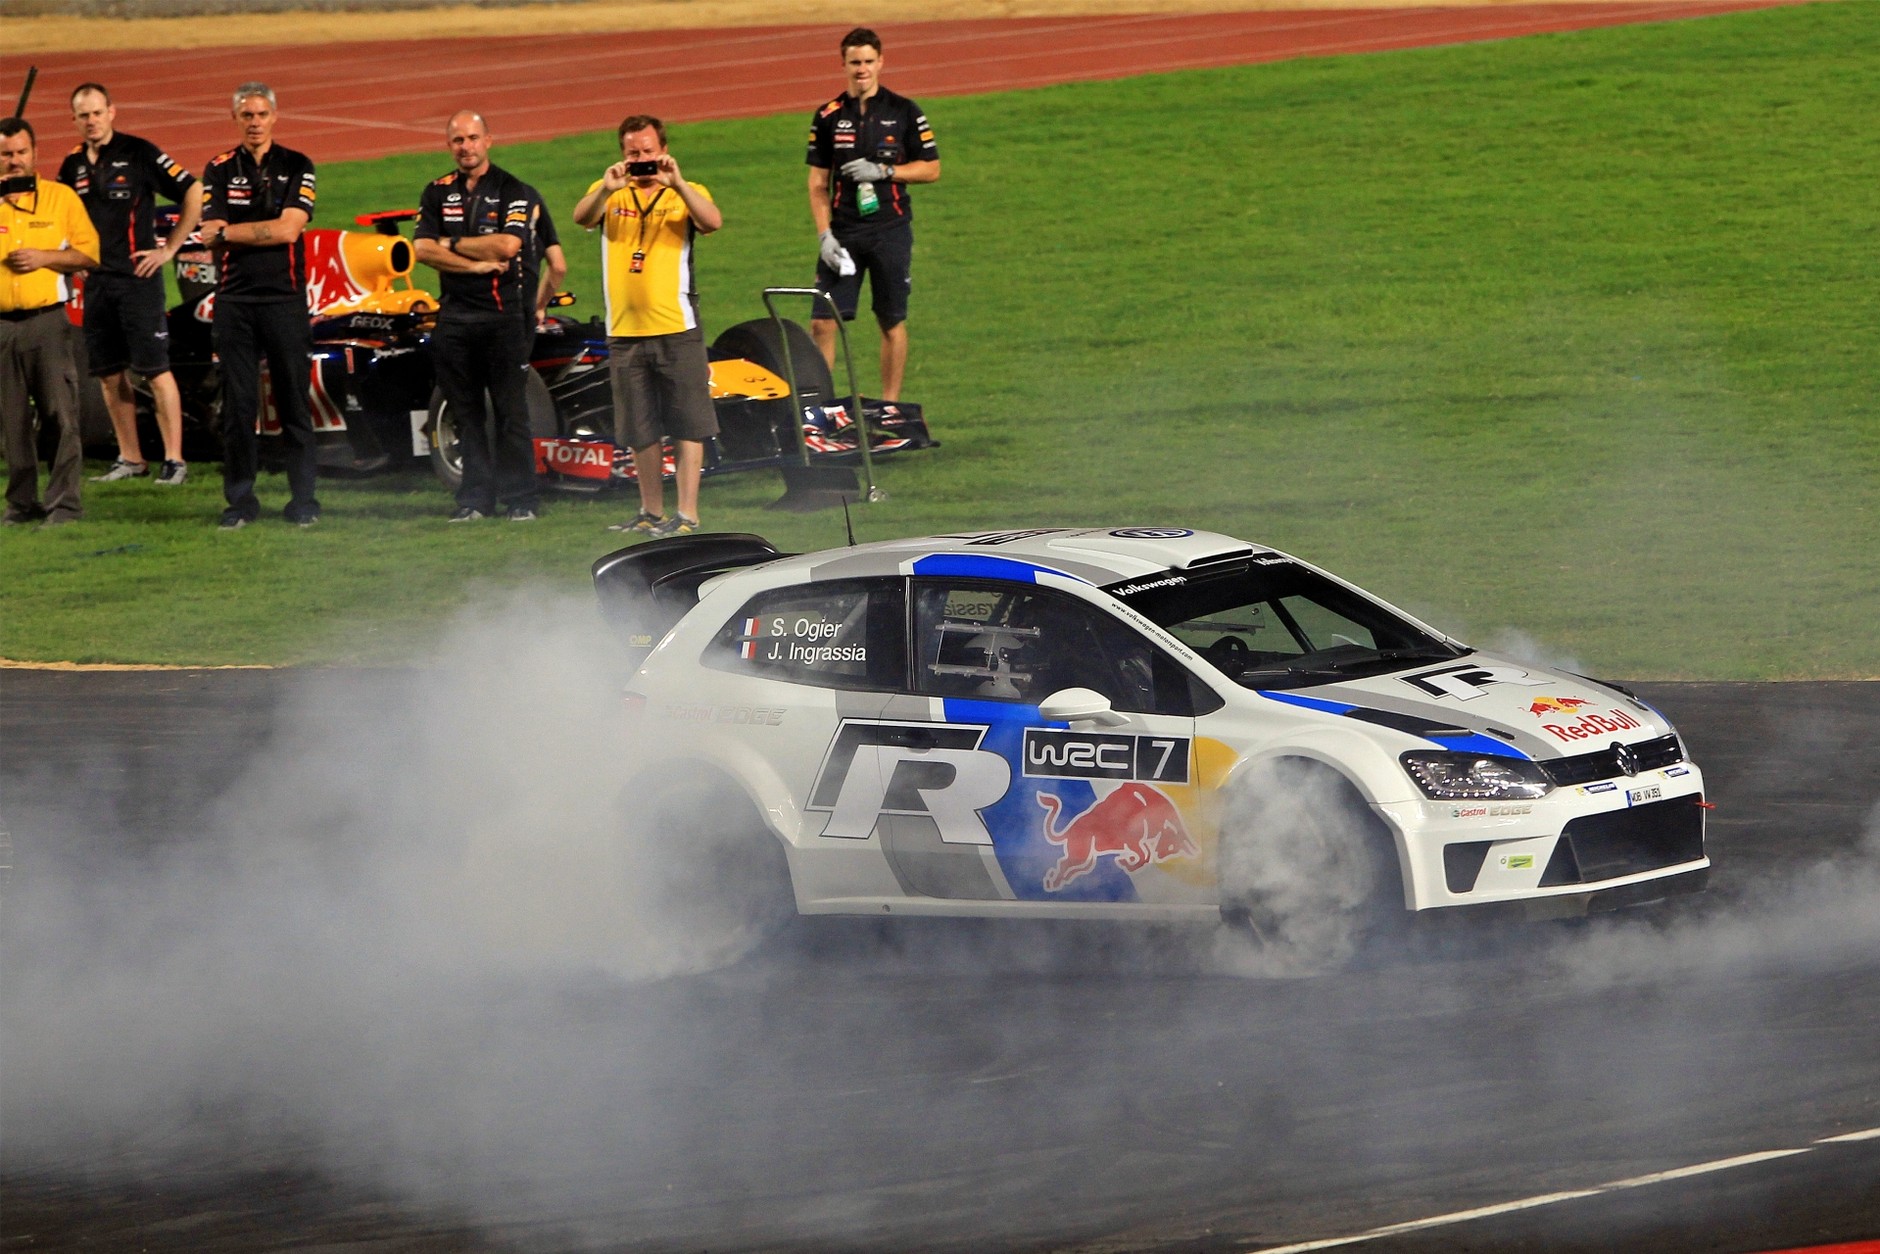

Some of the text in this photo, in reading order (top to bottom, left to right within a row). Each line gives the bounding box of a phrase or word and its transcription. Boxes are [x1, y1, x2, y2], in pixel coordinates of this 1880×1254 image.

[540, 441, 611, 467] TOTAL
[1111, 574, 1188, 598] Volkswagen
[771, 617, 843, 642] S. Ogier
[1111, 602, 1193, 661] www.volkswagen-motorsport.com
[767, 642, 867, 665] J. Ingrassia
[716, 705, 788, 727] EDGE
[1029, 739, 1176, 779] WRC 7
[1460, 804, 1534, 818] Castrol EDGE
